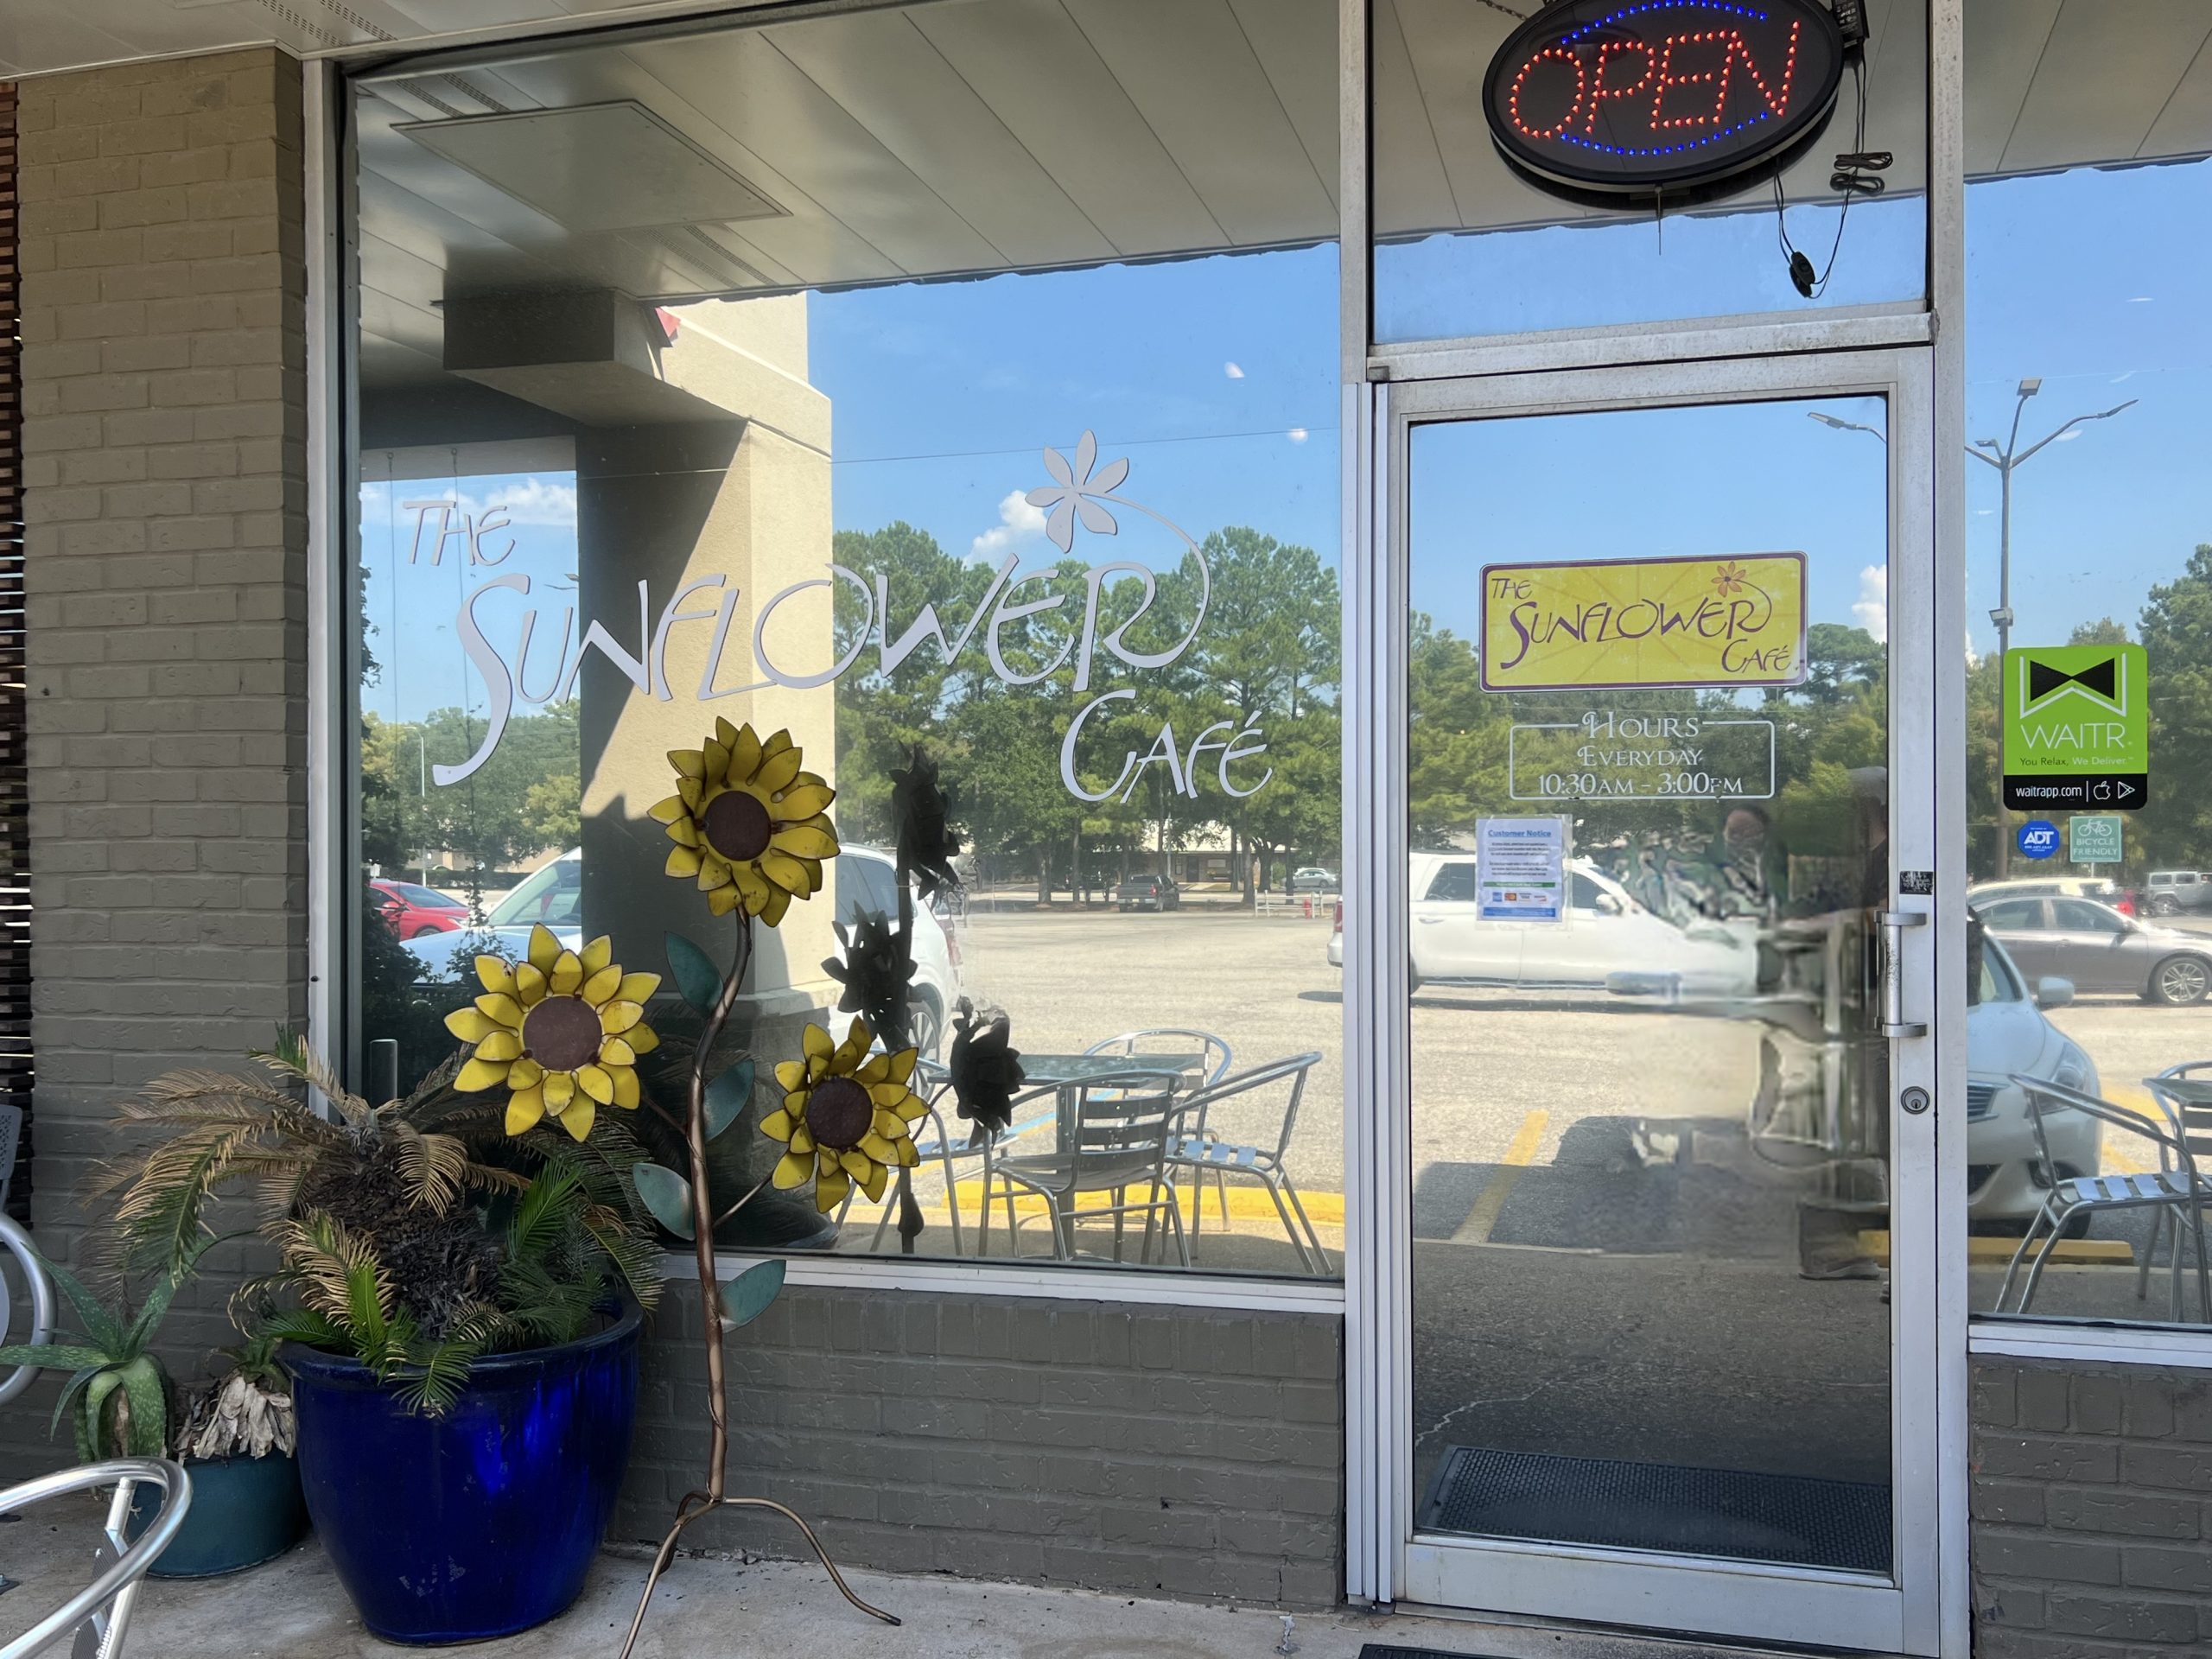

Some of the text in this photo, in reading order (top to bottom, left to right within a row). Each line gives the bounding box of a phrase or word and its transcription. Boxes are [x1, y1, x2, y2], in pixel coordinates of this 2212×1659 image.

[1508, 20, 1800, 140] OPEN
[403, 500, 515, 566] THE
[1491, 578, 1533, 600] THE
[1500, 596, 1772, 670] SUNFLOWER
[432, 551, 1210, 786] SUNFLOWER
[1721, 639, 1791, 674] CAFÉ
[1581, 711, 1700, 739] HOURS
[1060, 690, 1274, 804] CAFÉ
[1577, 745, 1704, 766] EVERYDAY
[2019, 758, 2037, 766] You
[2040, 757, 2069, 766] Relax,
[2072, 757, 2088, 766] We
[2016, 785, 2082, 798] waitrapp.com
[2024, 831, 2054, 844] ADT
